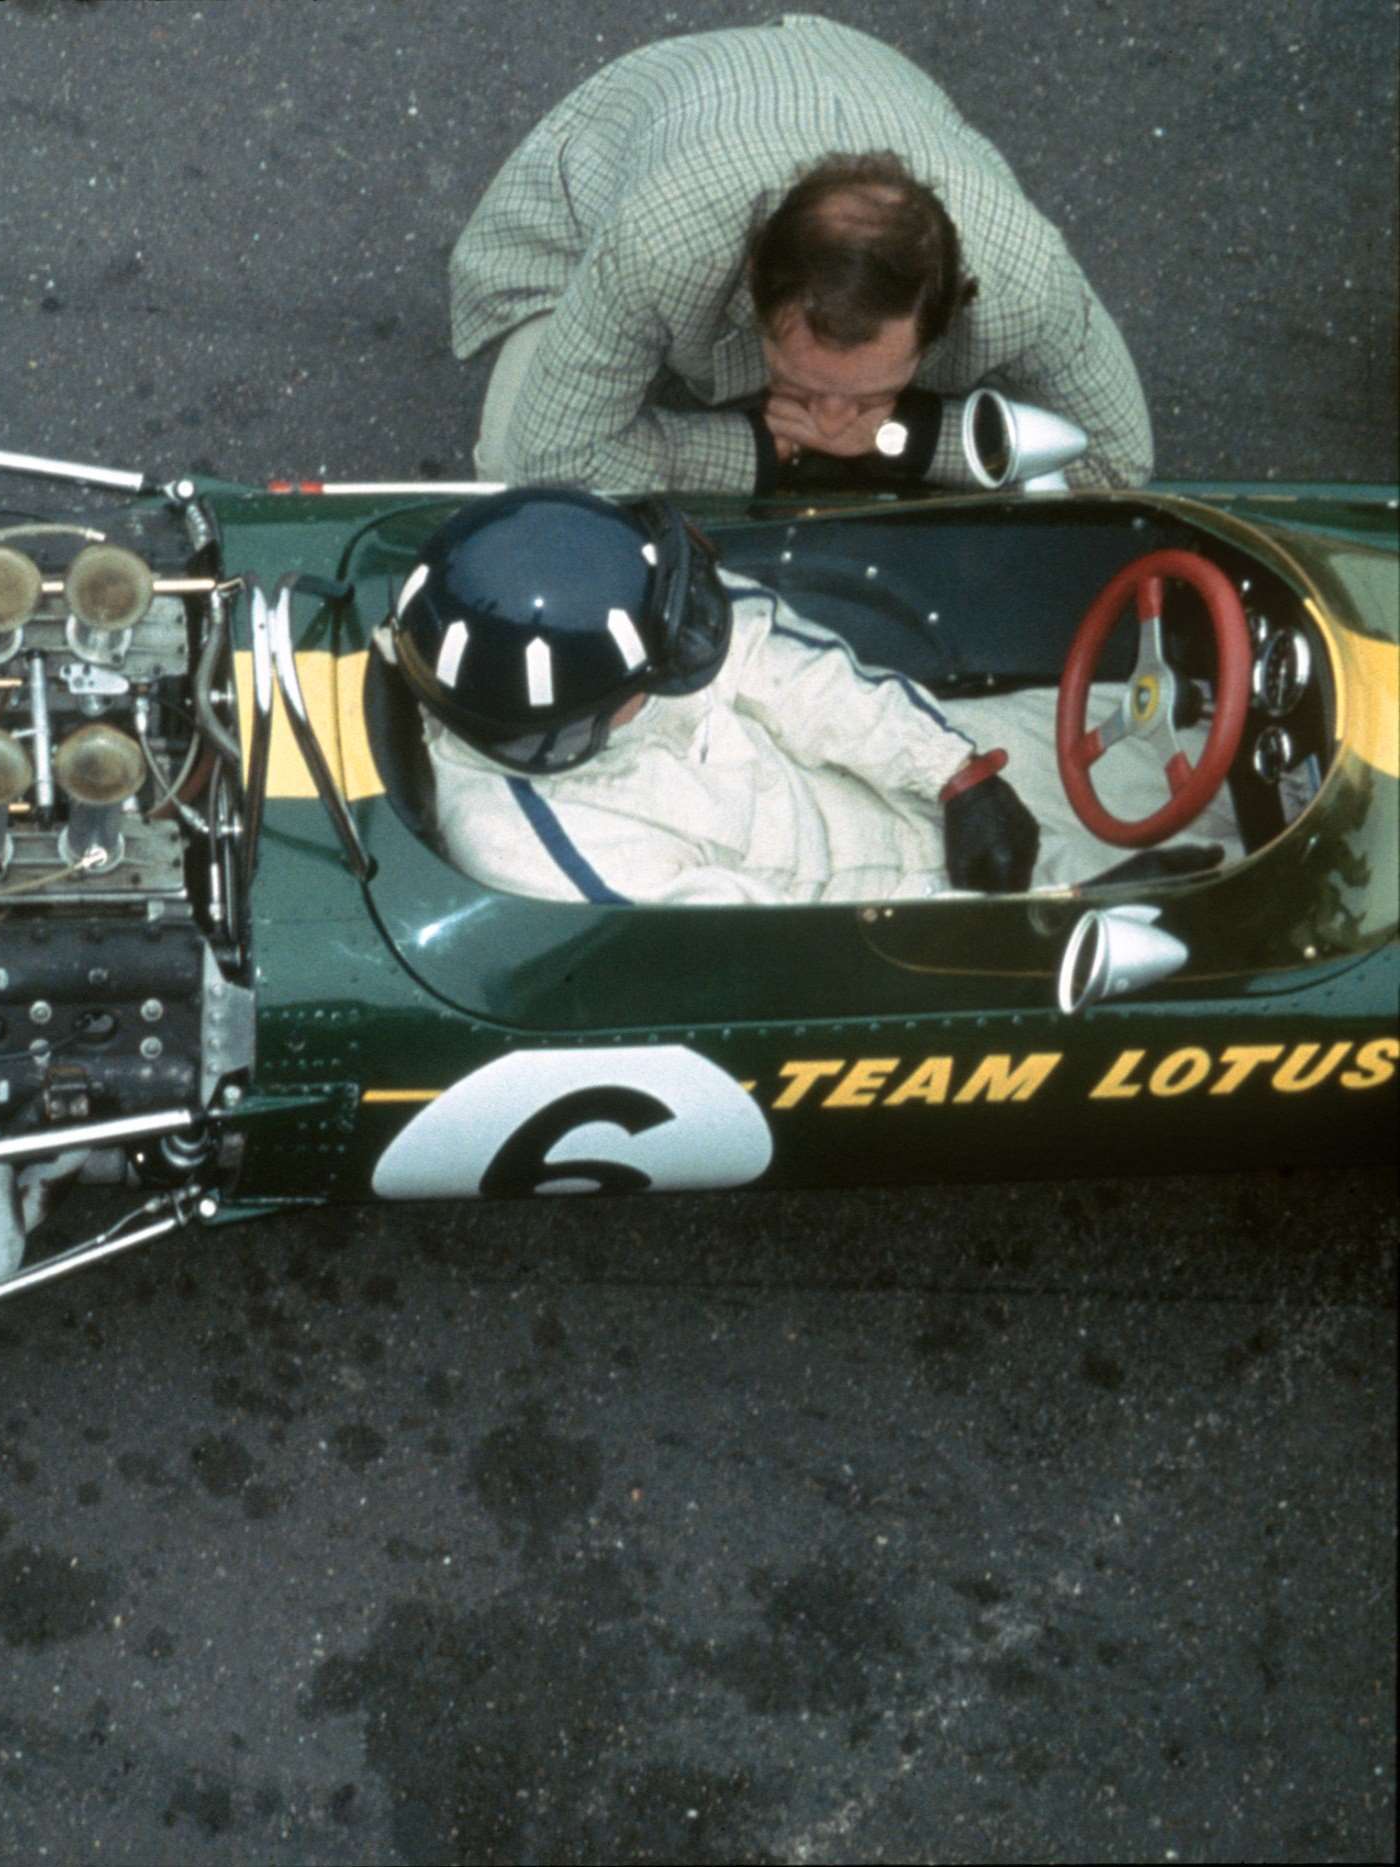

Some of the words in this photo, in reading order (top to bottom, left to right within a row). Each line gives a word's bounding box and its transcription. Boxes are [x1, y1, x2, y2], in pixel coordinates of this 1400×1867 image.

[773, 1052, 1063, 1109] TEAM
[1090, 1038, 1400, 1098] LOTUS
[478, 1084, 677, 1198] 6
